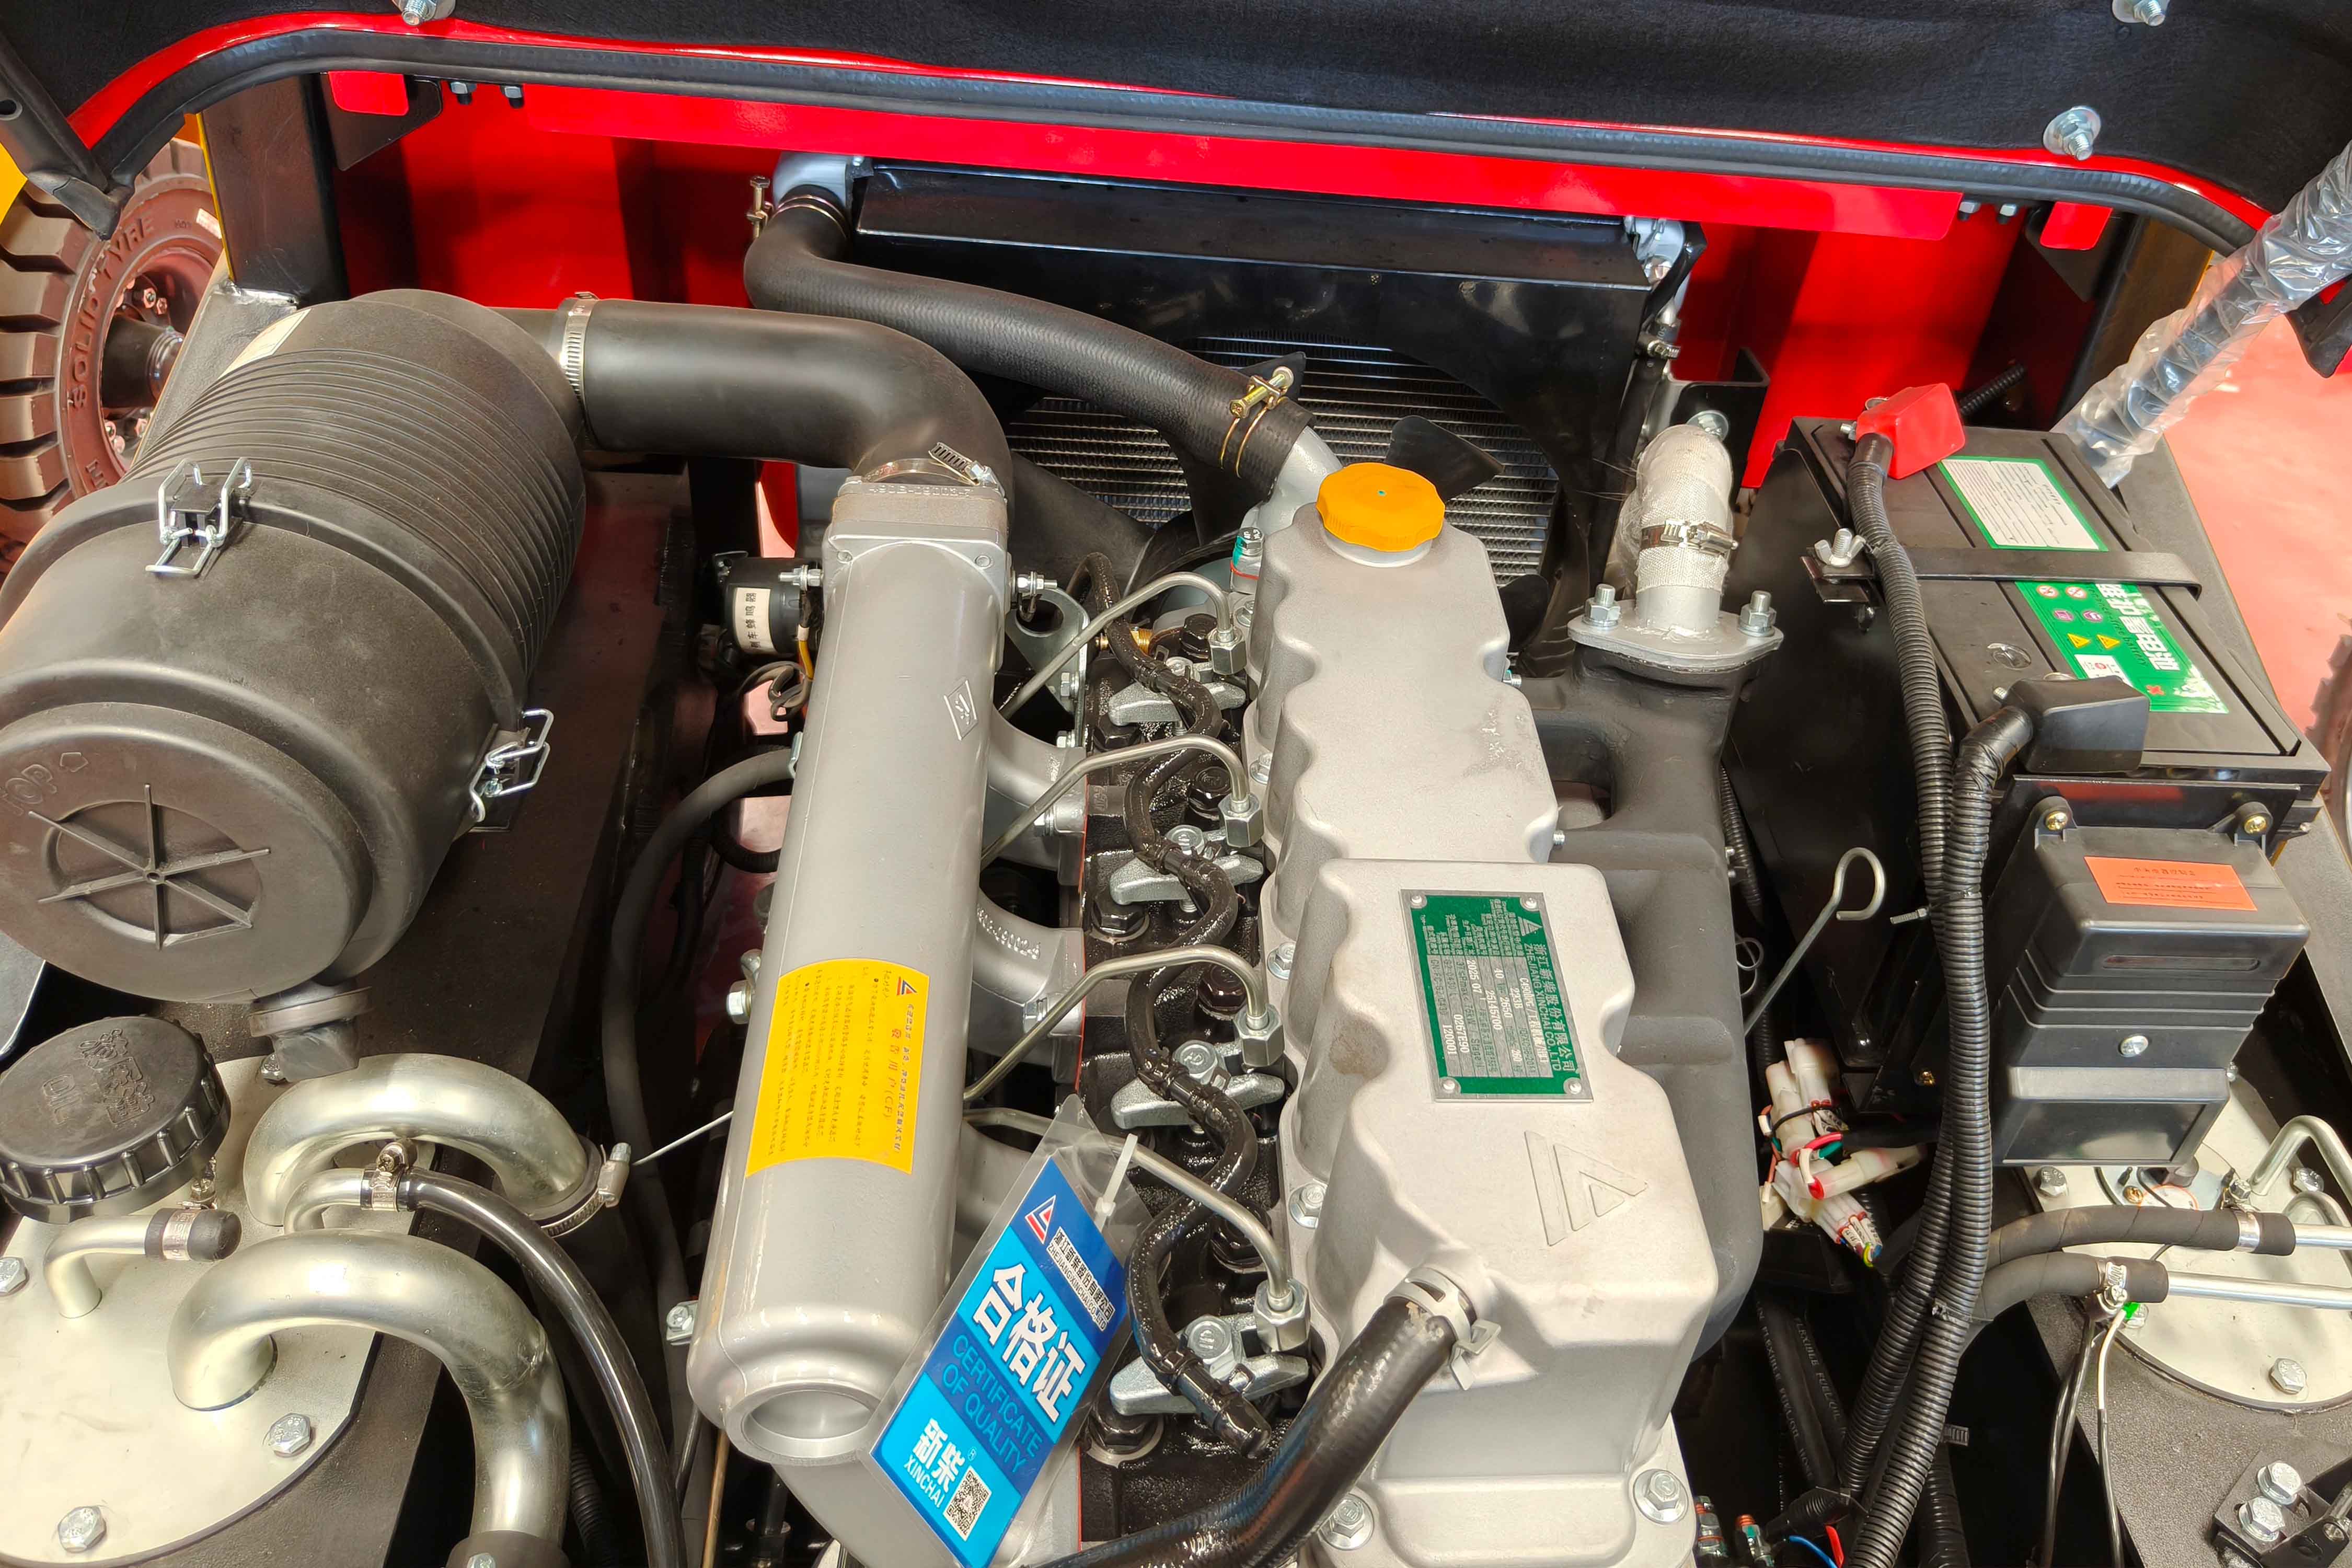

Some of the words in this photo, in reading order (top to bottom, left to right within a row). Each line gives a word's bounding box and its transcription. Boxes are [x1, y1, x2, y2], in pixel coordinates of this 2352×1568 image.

[70, 296, 99, 408] SOLID
[99, 217, 155, 280] TYRE
[1466, 959, 1479, 979] 2025
[1471, 982, 1482, 993] 07
[1493, 967, 1504, 979] 40
[1499, 996, 1513, 1018] 2650
[1524, 943, 1541, 989] ZHEJIANG
[1535, 990, 1552, 1031] XINCHAI
[1442, 1024, 1457, 1055] 120001
[1453, 1013, 1469, 1053] 0267E90
[1484, 989, 1502, 1030] 25145700
[1532, 943, 1575, 1072] 浙江新柴股份有限公司
[1055, 1227, 1114, 1322] 浙江新柴股份有限公司
[973, 1263, 1086, 1425] 合格证
[942, 1363, 965, 1397] OF
[963, 1392, 1029, 1474] QUALITY
[952, 1334, 1044, 1458] CERTIFICATE
[903, 1456, 945, 1507] XINCHAI
[912, 1418, 965, 1493] 新柴
